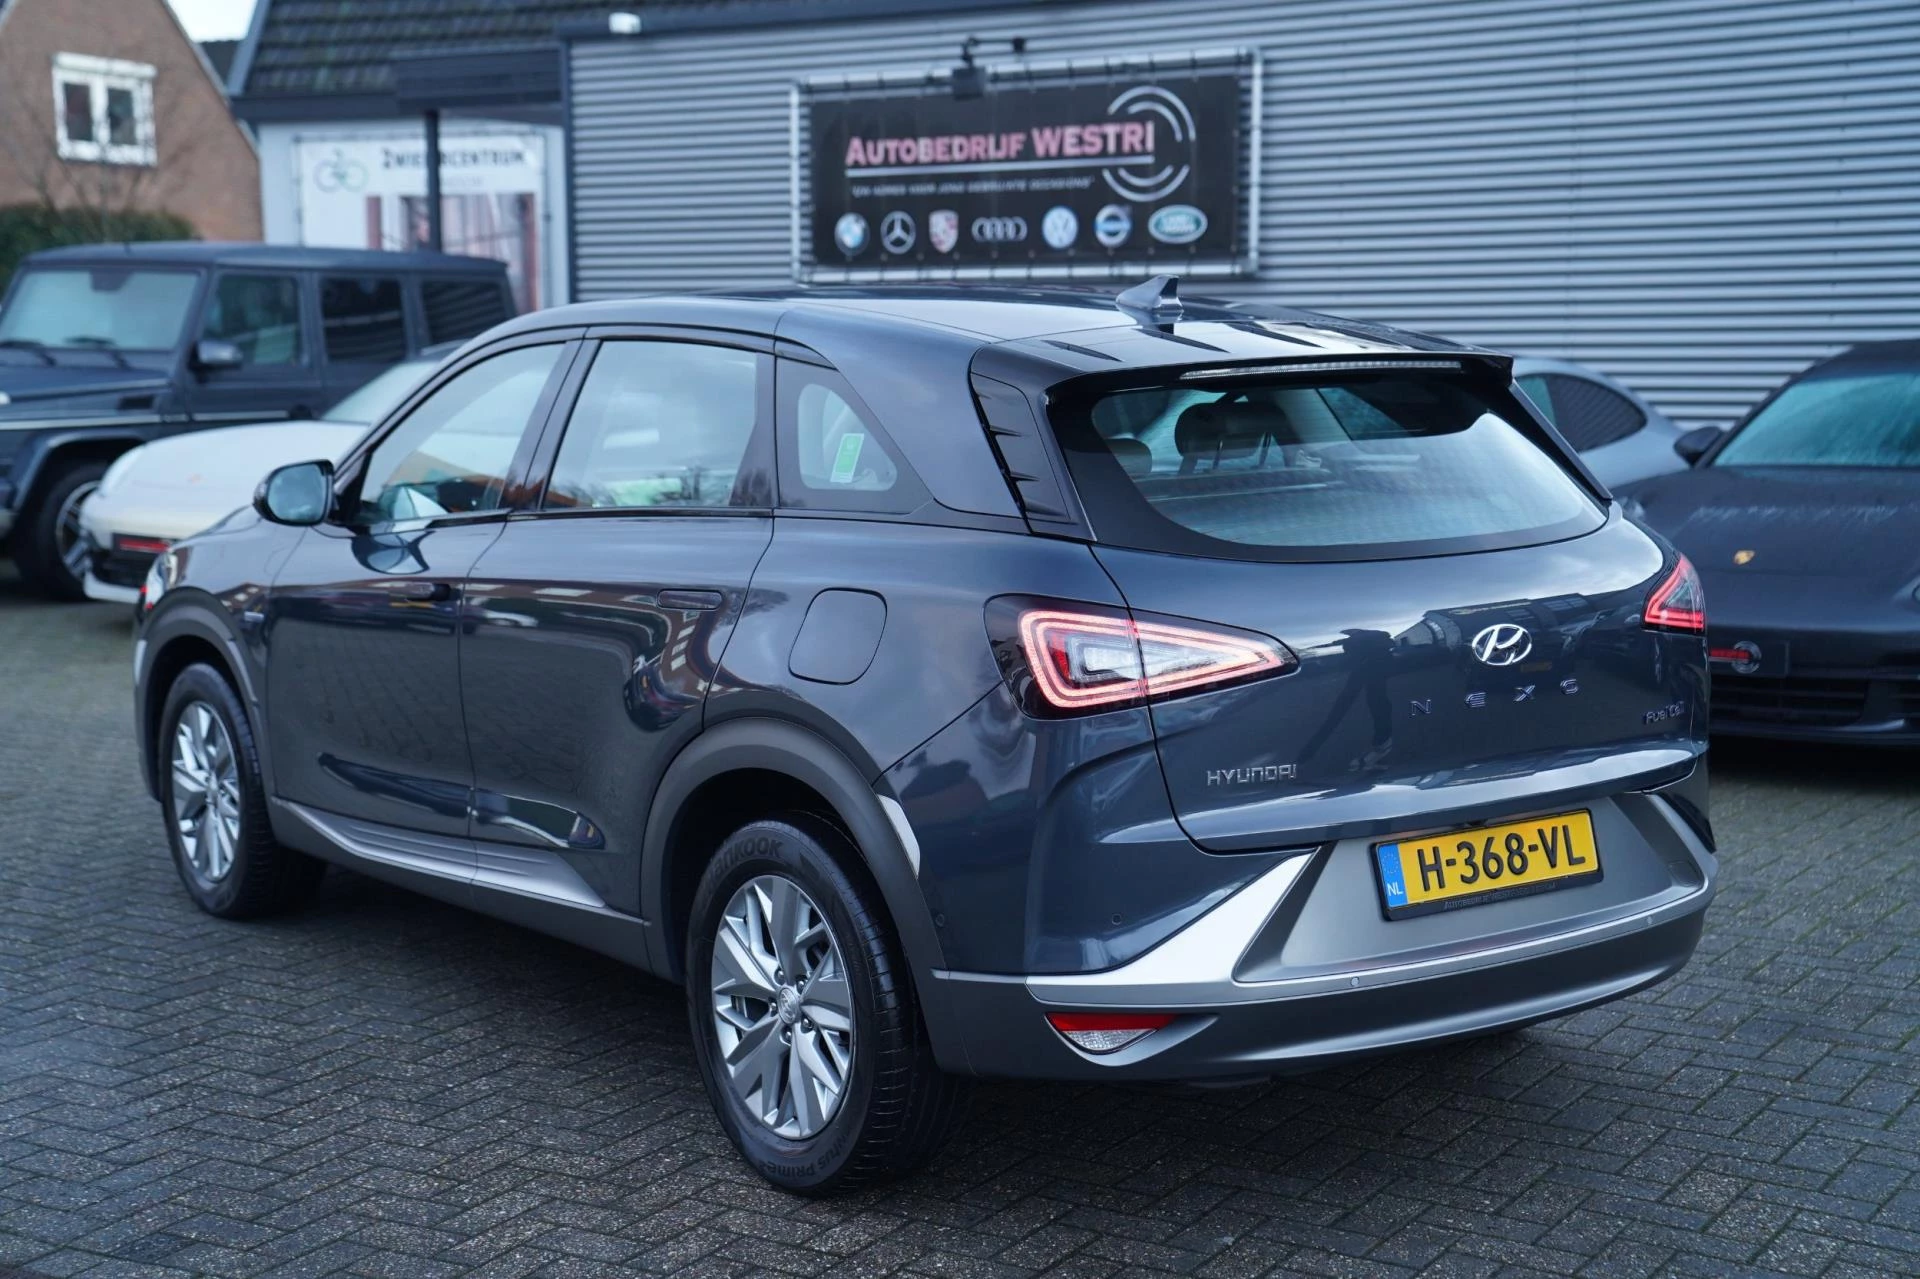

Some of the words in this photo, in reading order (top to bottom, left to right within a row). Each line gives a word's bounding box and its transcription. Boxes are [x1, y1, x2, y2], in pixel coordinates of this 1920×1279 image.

[845, 131, 1027, 167] AUTOBEDRIJF
[1031, 120, 1156, 158] WESTRI
[1206, 763, 1297, 787] HYUNDAI
[1417, 825, 1586, 892] H-368-VL
[1387, 882, 1404, 896] NL
